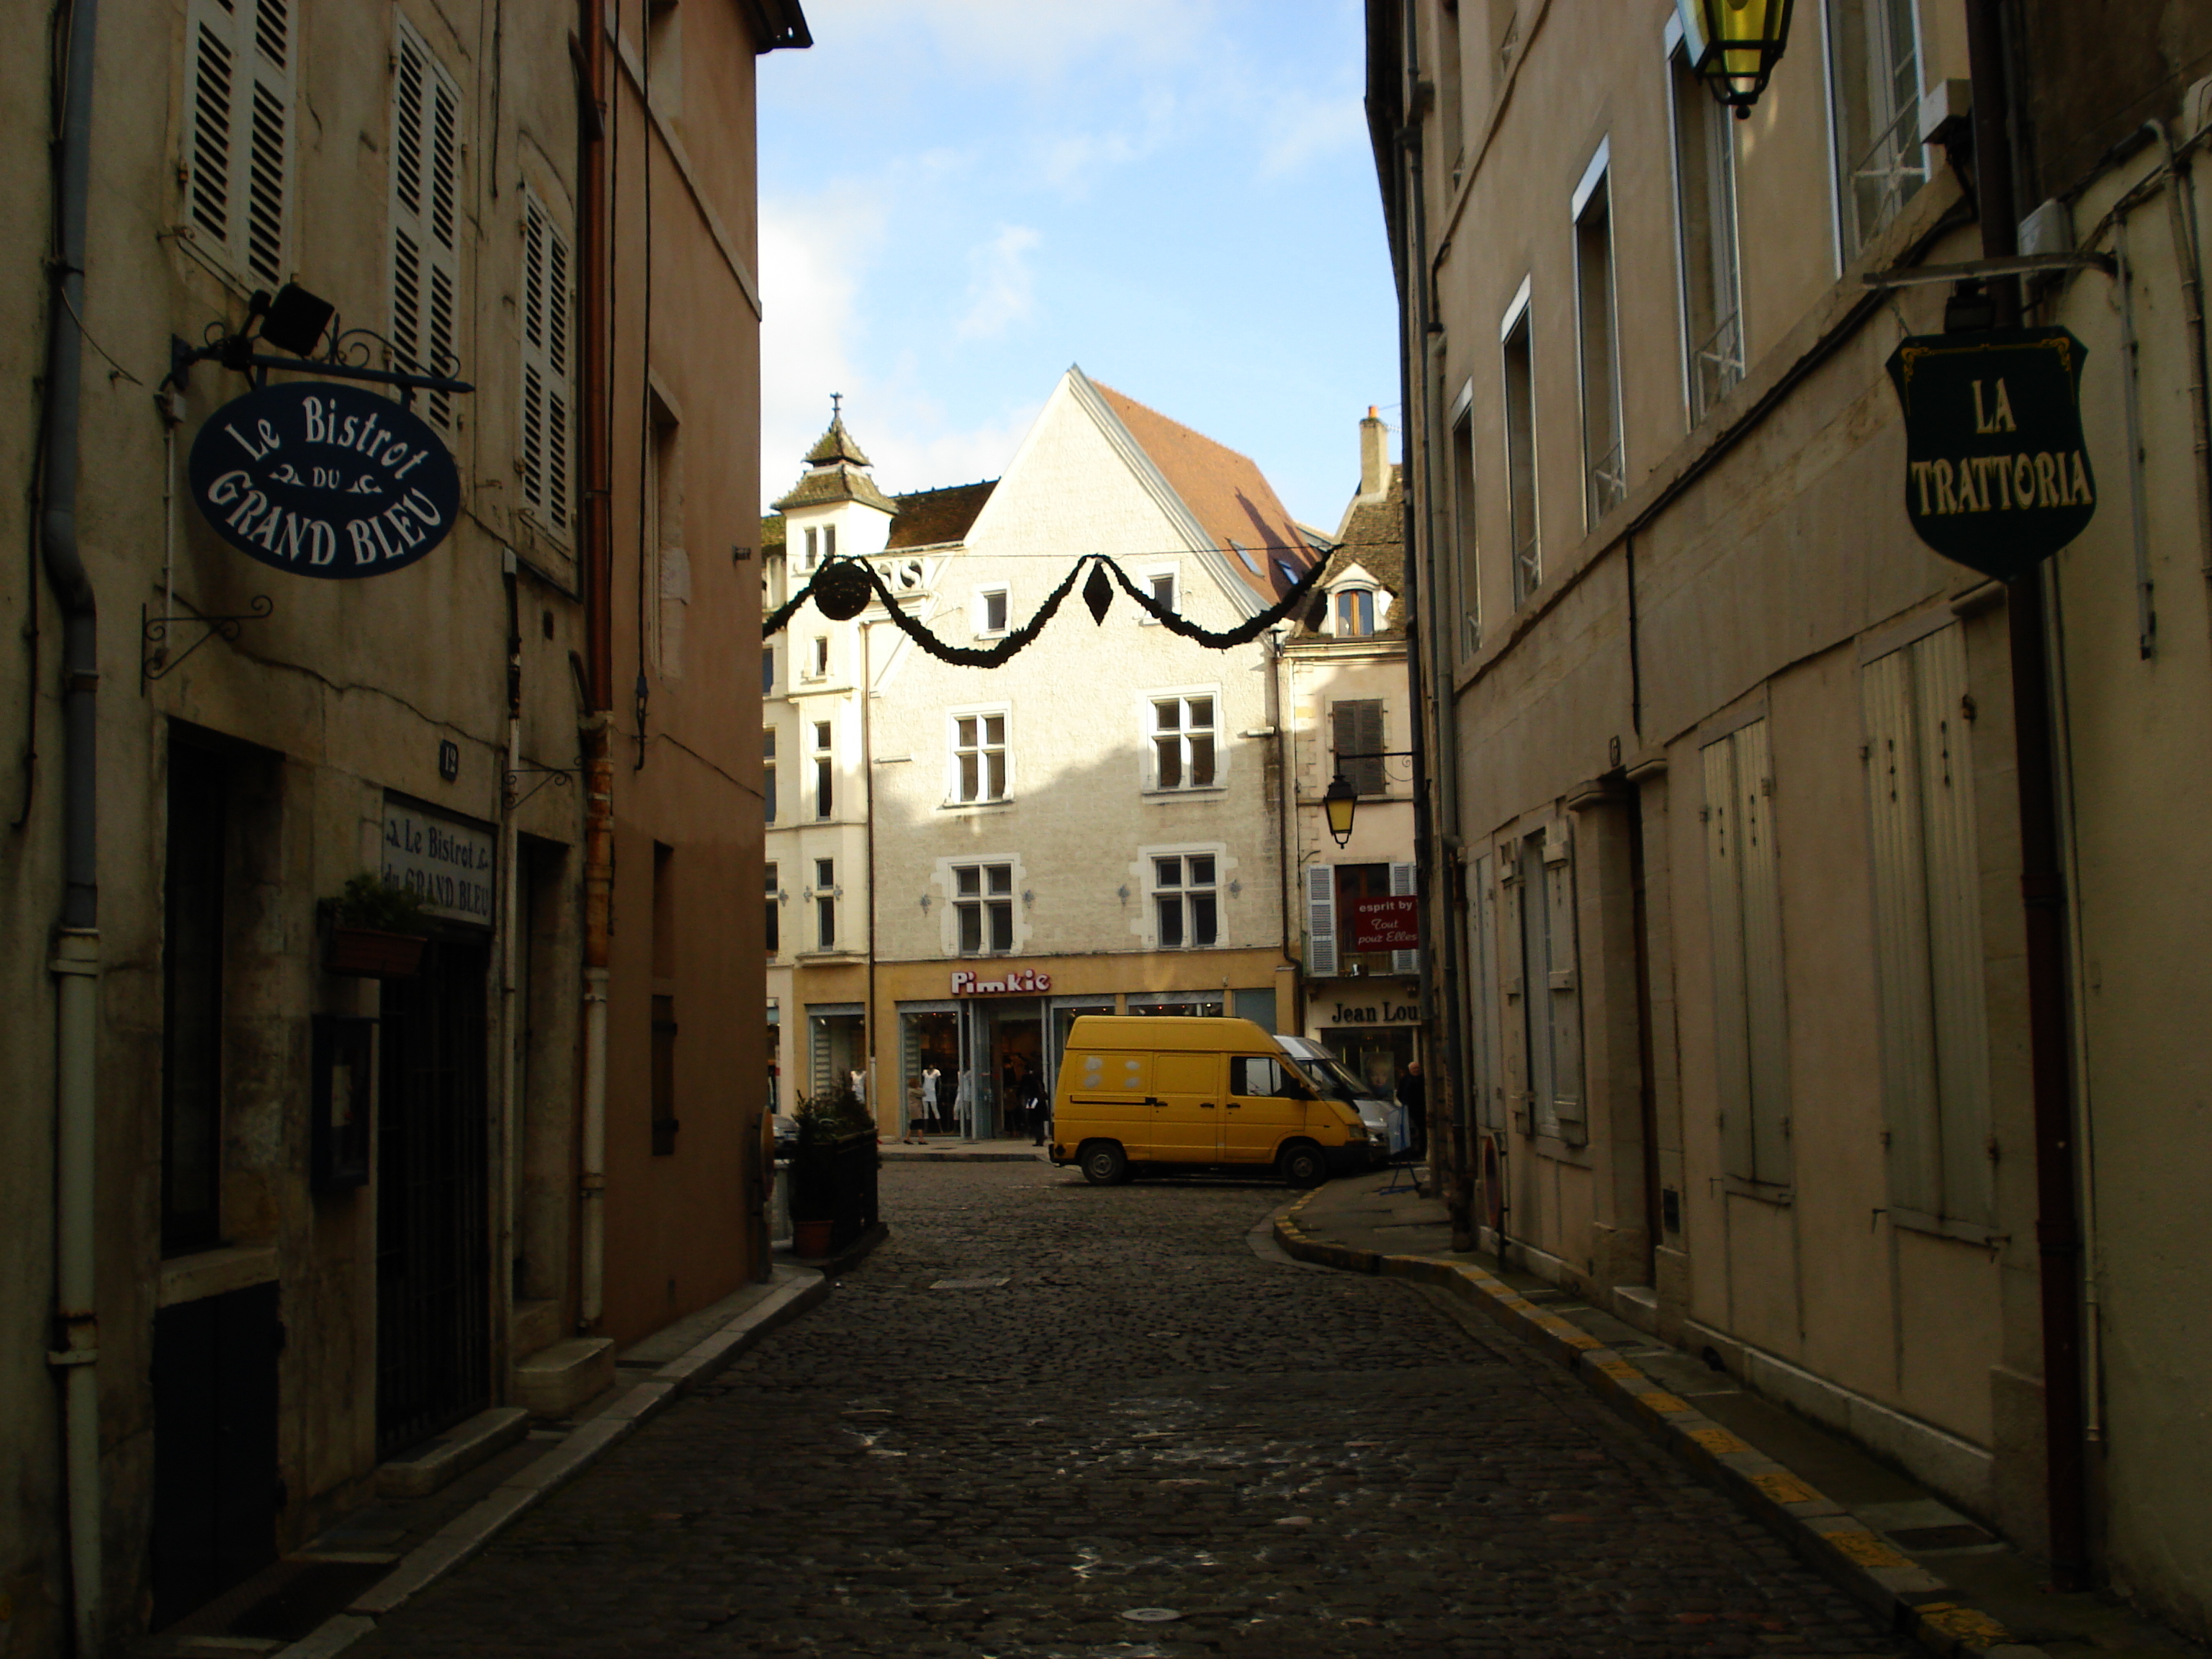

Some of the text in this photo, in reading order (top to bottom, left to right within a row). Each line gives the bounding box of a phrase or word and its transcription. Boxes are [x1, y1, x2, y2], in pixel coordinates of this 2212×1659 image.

[1972, 377, 2016, 433] LA
[224, 395, 430, 480] Le Bistrot
[313, 466, 341, 490] DU
[1910, 449, 2094, 516] TRATTORIA
[207, 469, 442, 565] GRAND BLEU
[405, 819, 472, 870] Le Bistrot
[405, 867, 454, 907] GRAND
[459, 880, 488, 916] BLEU
[1359, 899, 1413, 914] esprit by
[1358, 930, 1418, 945] pour Elles
[1371, 918, 1398, 930] Tout
[951, 968, 1051, 994] Pimkie
[1332, 1002, 1421, 1022] Jean Lou
